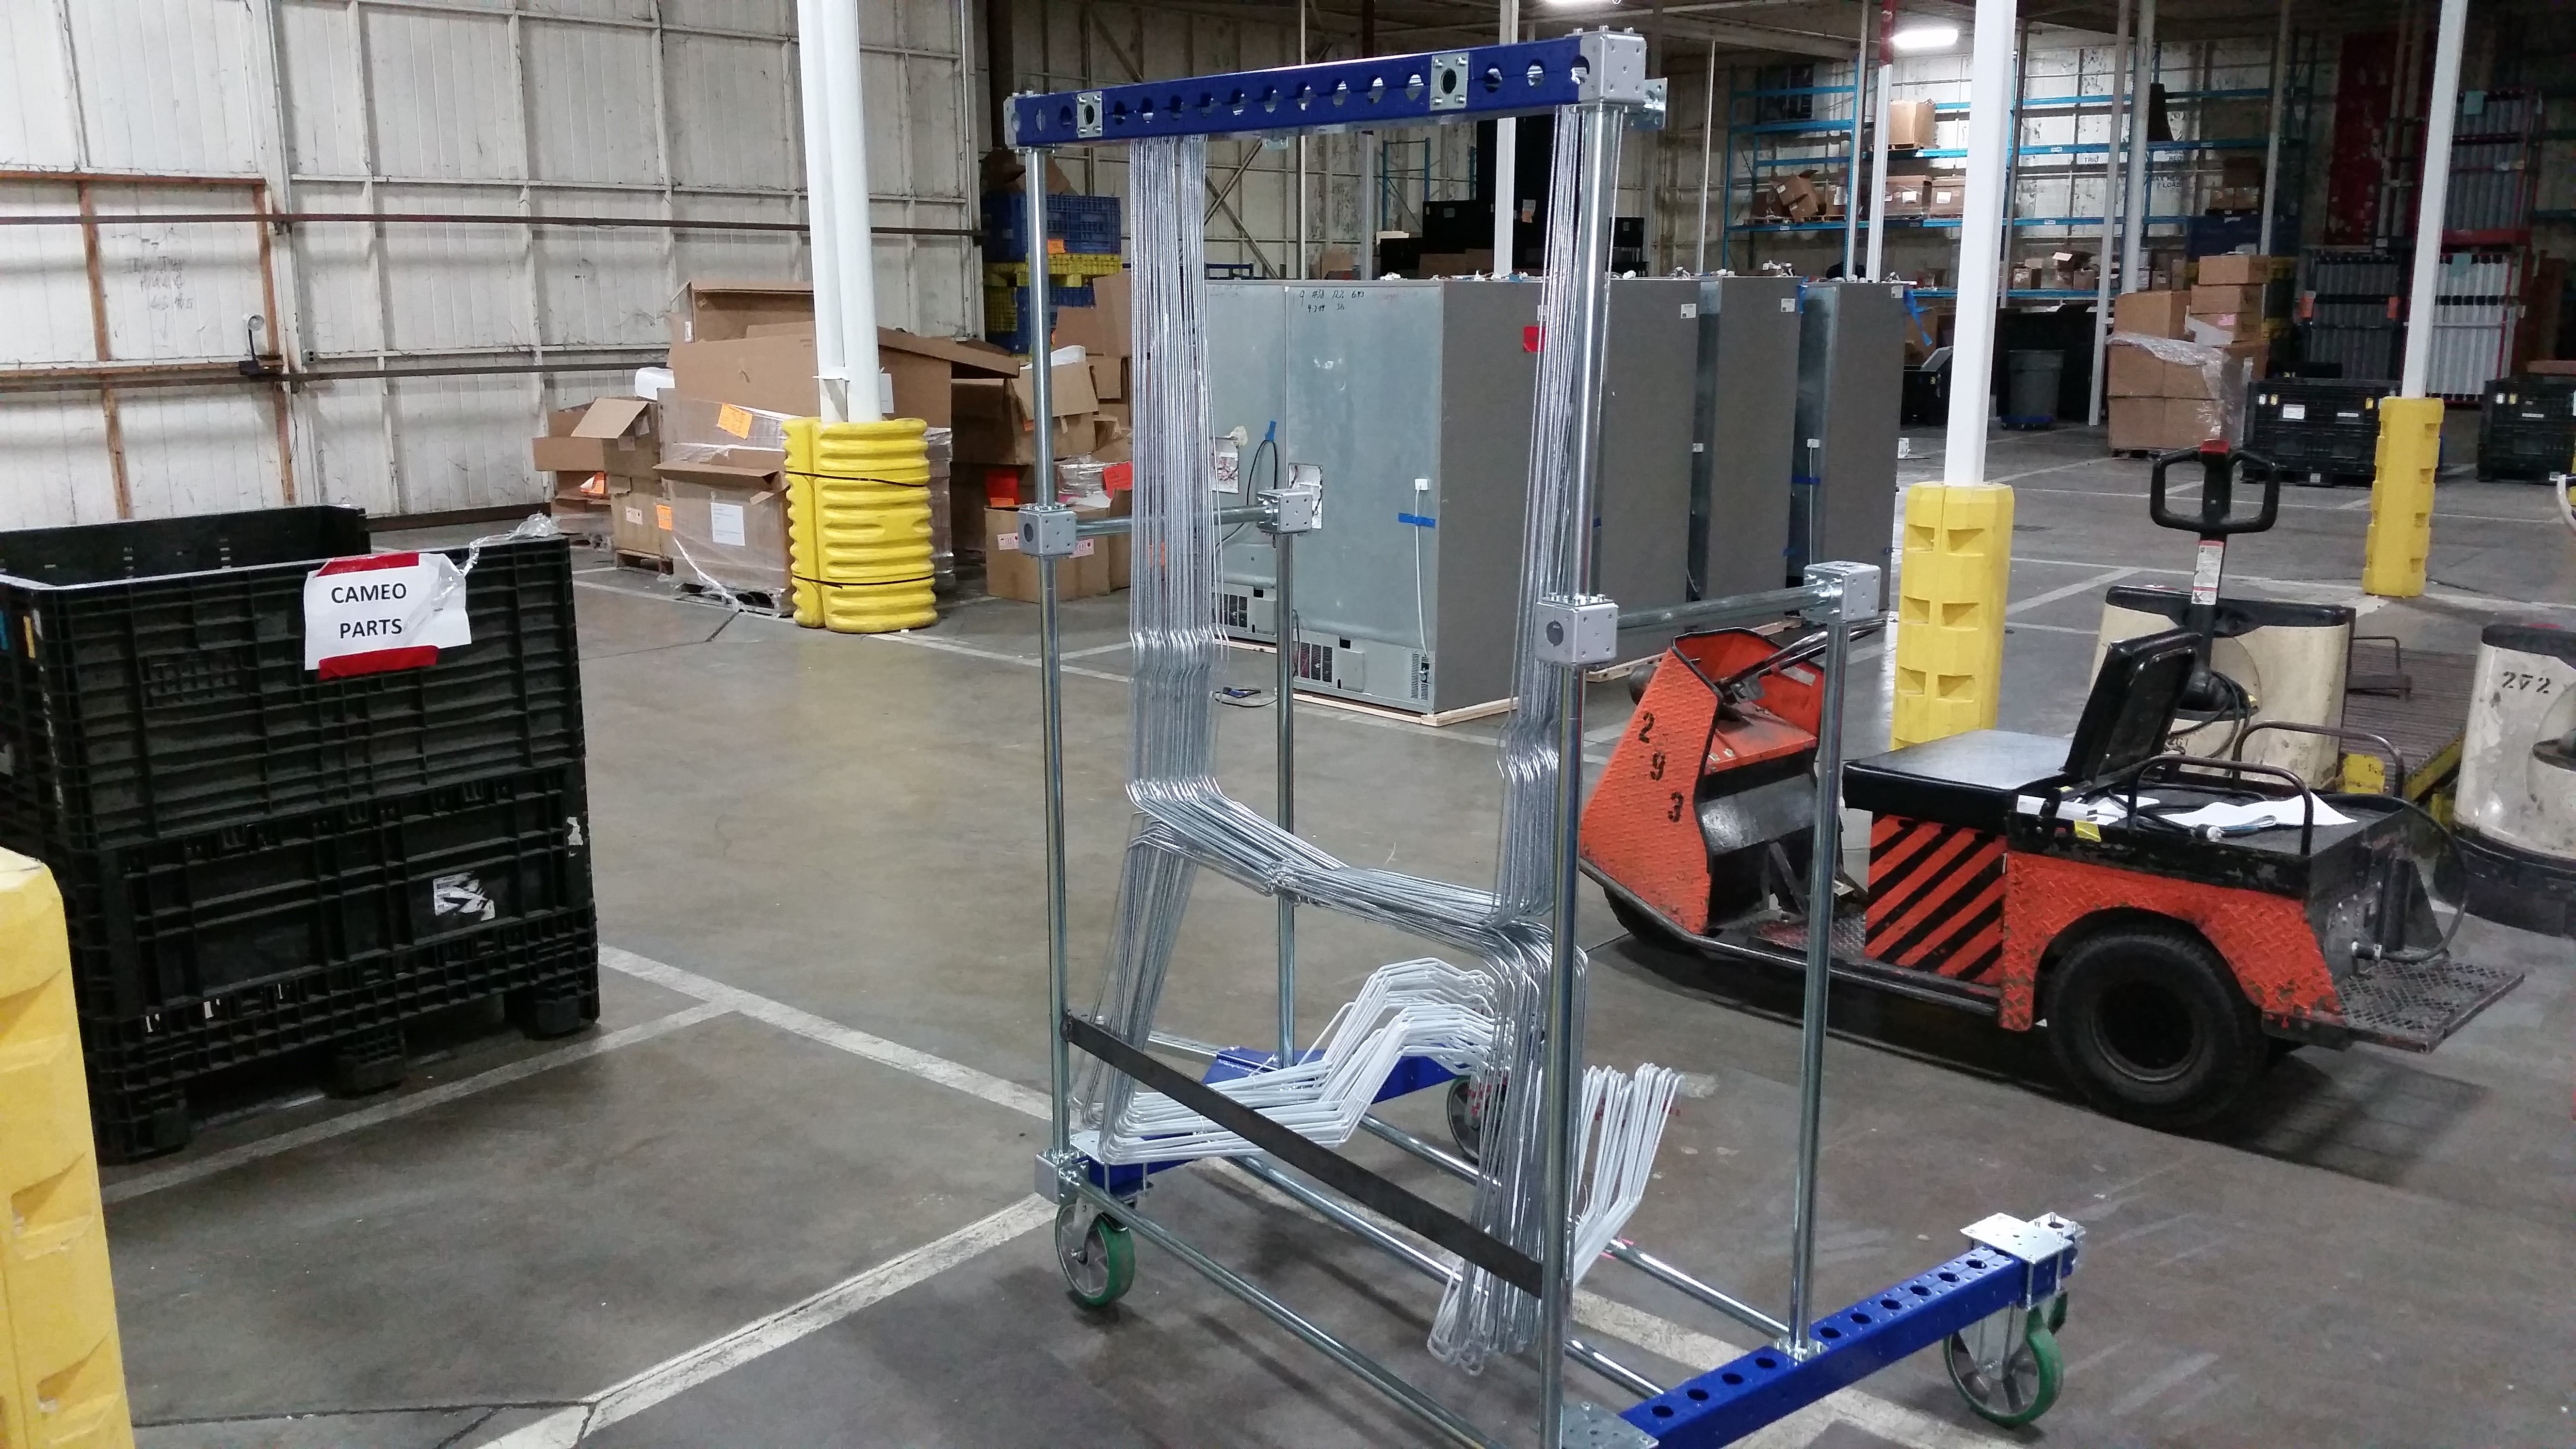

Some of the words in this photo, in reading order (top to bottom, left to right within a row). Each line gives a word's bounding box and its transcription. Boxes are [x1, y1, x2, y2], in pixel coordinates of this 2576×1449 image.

[331, 582, 407, 604] CAMEO
[340, 618, 402, 639] PARTS
[2502, 671, 2551, 694] 272
